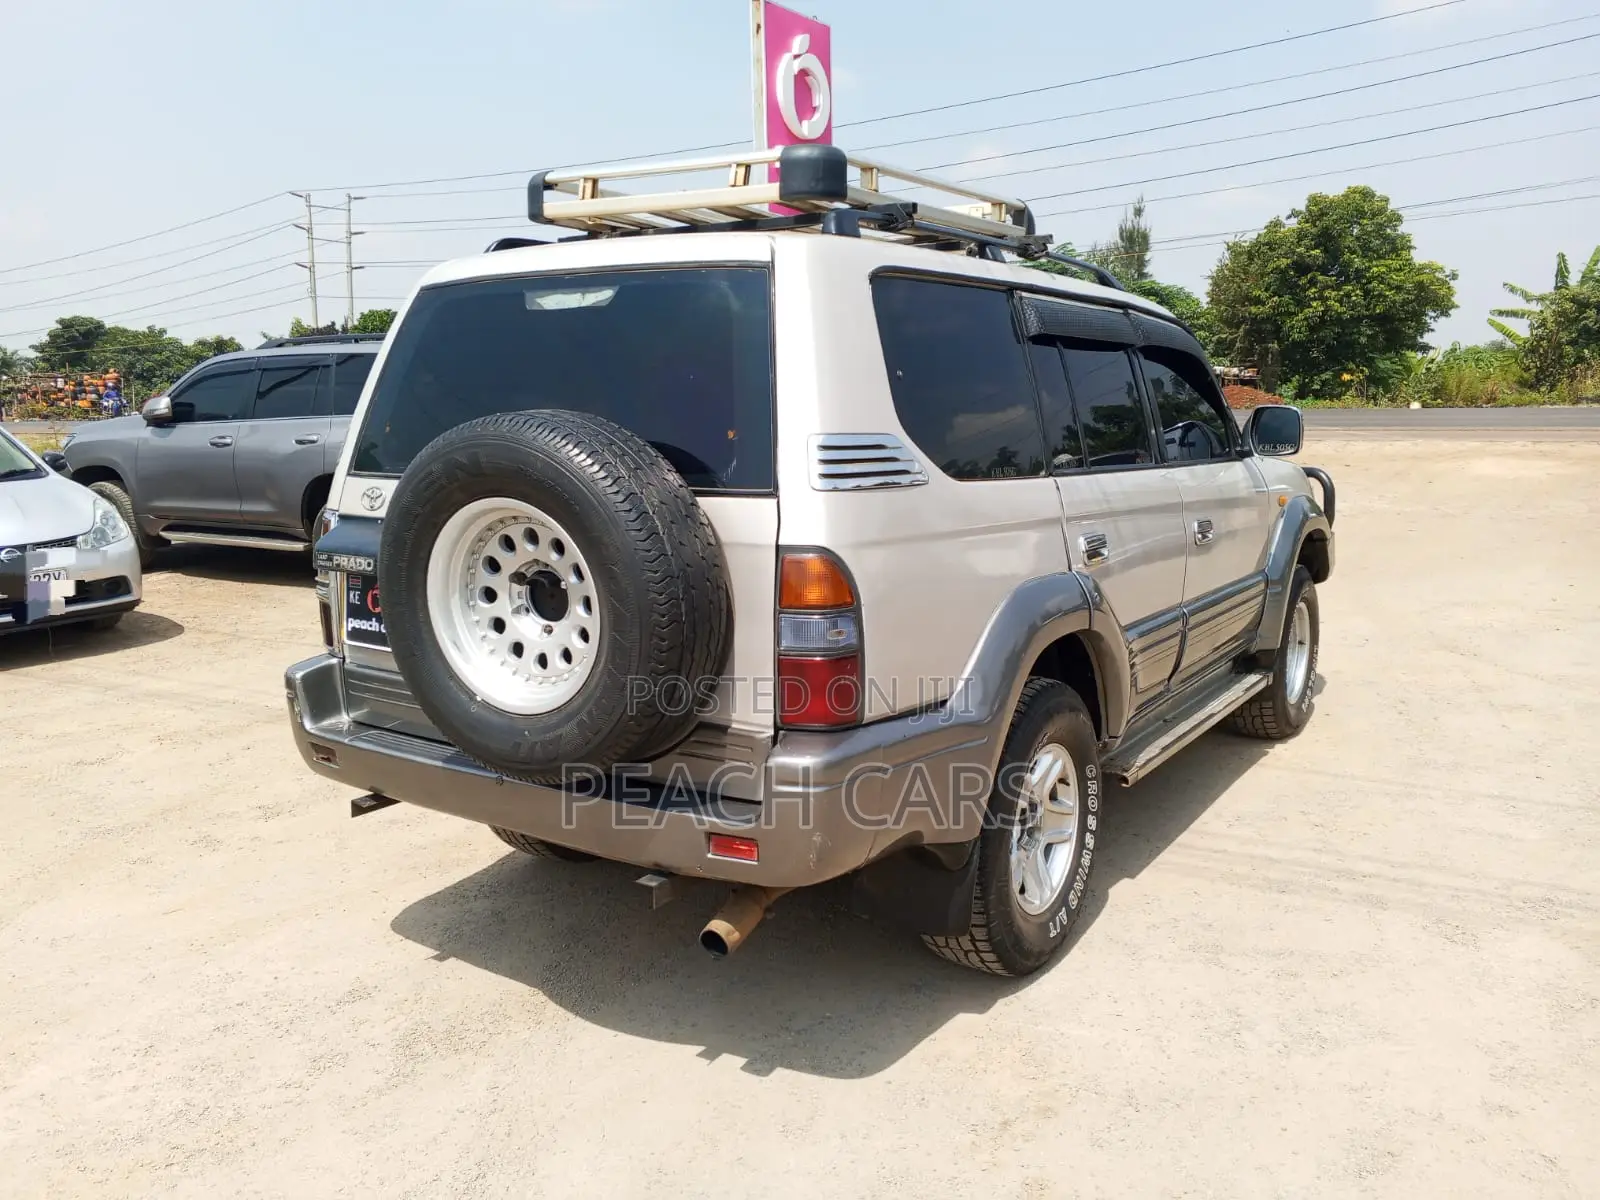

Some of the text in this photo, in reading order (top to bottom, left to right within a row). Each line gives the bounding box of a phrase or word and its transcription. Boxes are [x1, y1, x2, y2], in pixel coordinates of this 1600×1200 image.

[333, 556, 374, 571] PRADO
[349, 590, 361, 604] KE
[347, 618, 380, 632] peach
[1069, 764, 1098, 909] CROSSWIND
